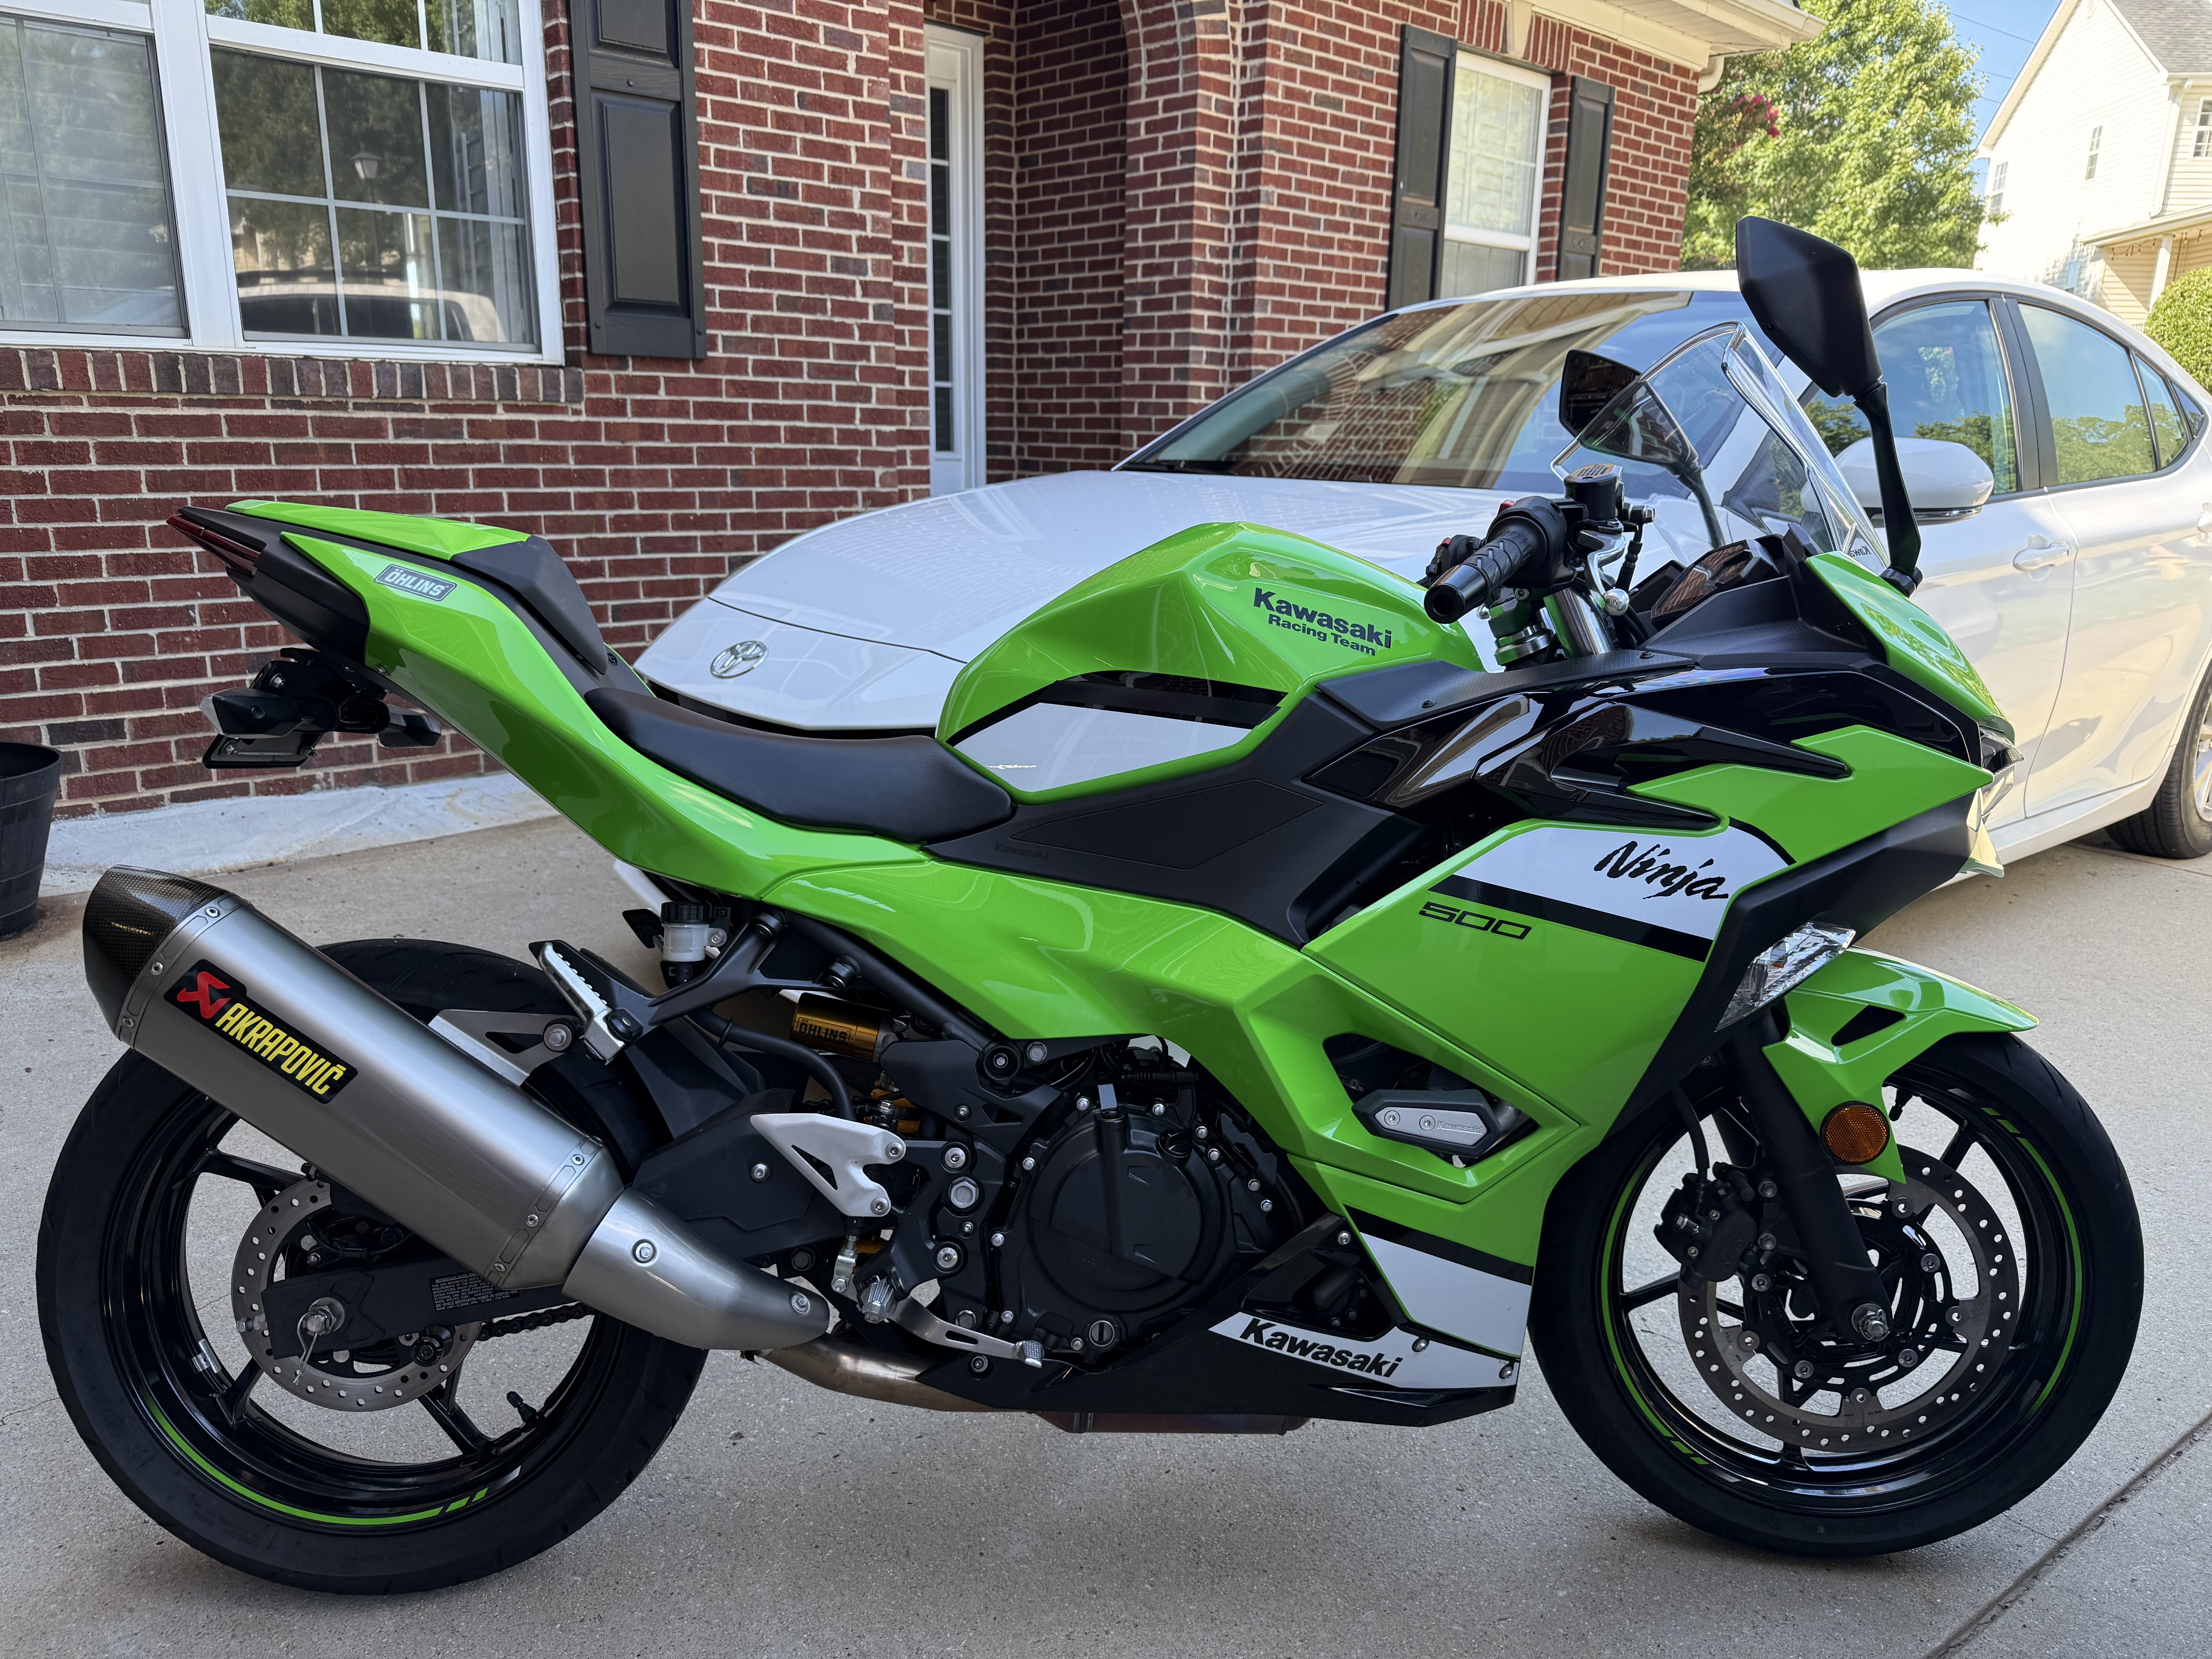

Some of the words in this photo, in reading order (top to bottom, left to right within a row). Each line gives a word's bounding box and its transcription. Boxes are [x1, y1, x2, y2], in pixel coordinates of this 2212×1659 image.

[385, 568, 446, 596] ÖHLINS
[1254, 587, 1392, 649] Kawasaki
[1268, 613, 1327, 642] Racing
[1331, 632, 1376, 656] Team
[994, 842, 1048, 860] Kawasaki
[1594, 840, 1729, 900] Ninja
[1418, 901, 1532, 940] 500
[799, 1019, 847, 1043] ÖHLINS
[1437, 1120, 1483, 1135] Kawasaki
[1722, 1235, 1744, 1264] NIIN
[1239, 1317, 1403, 1378] Kawasaki
